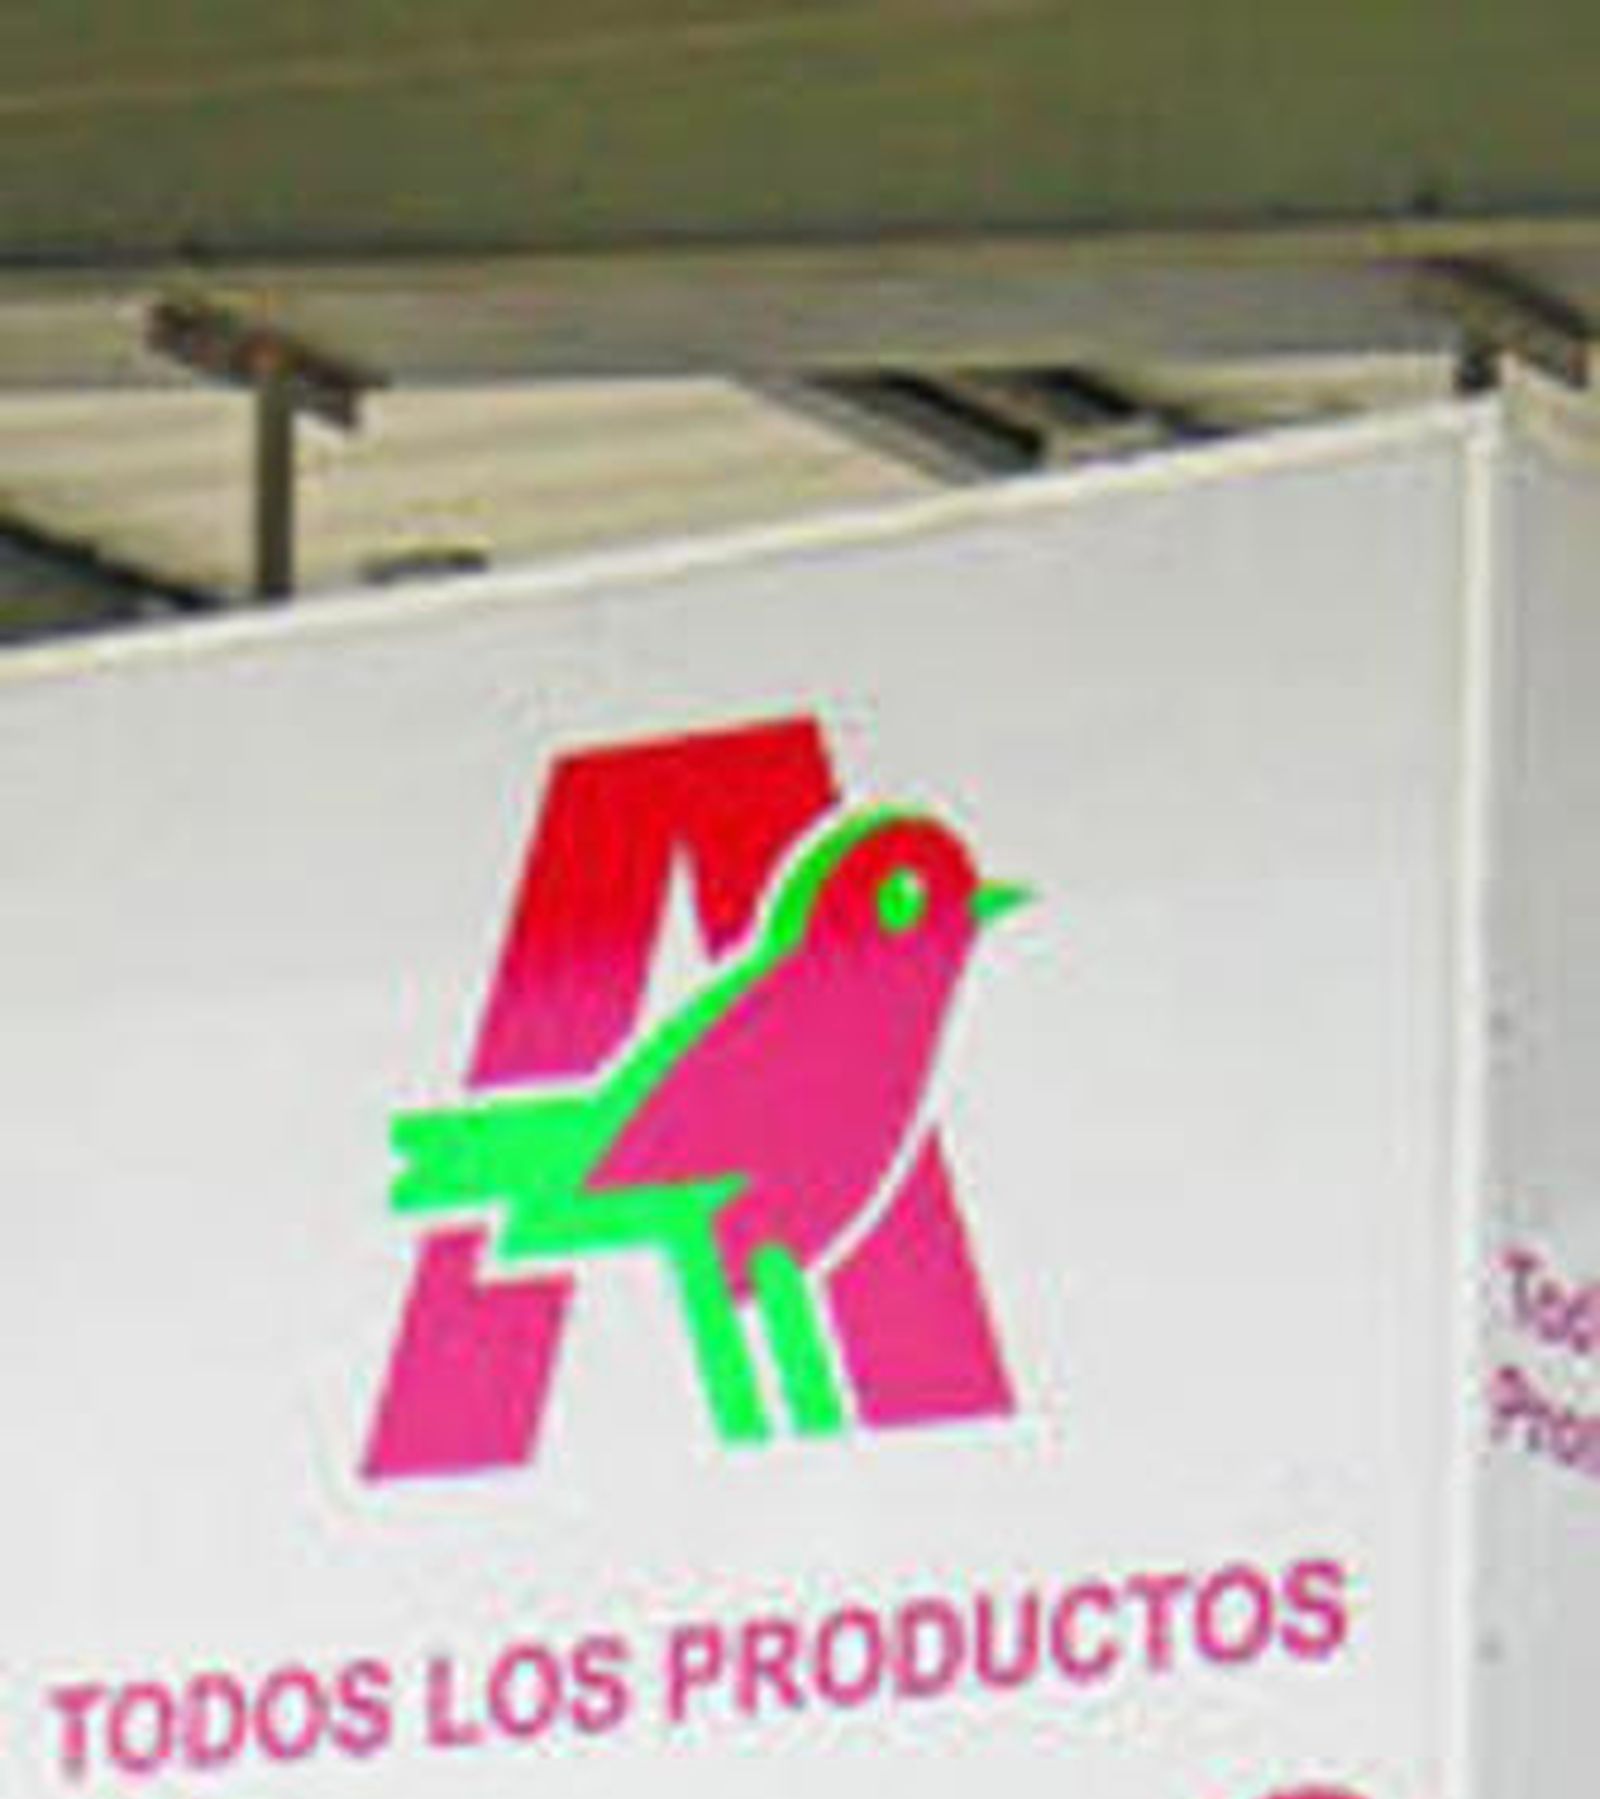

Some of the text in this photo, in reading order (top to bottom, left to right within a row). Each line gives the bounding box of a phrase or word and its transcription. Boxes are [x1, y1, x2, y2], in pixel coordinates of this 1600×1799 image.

[52, 1559, 1349, 1778] TODOS LOS PRODUCTOS
